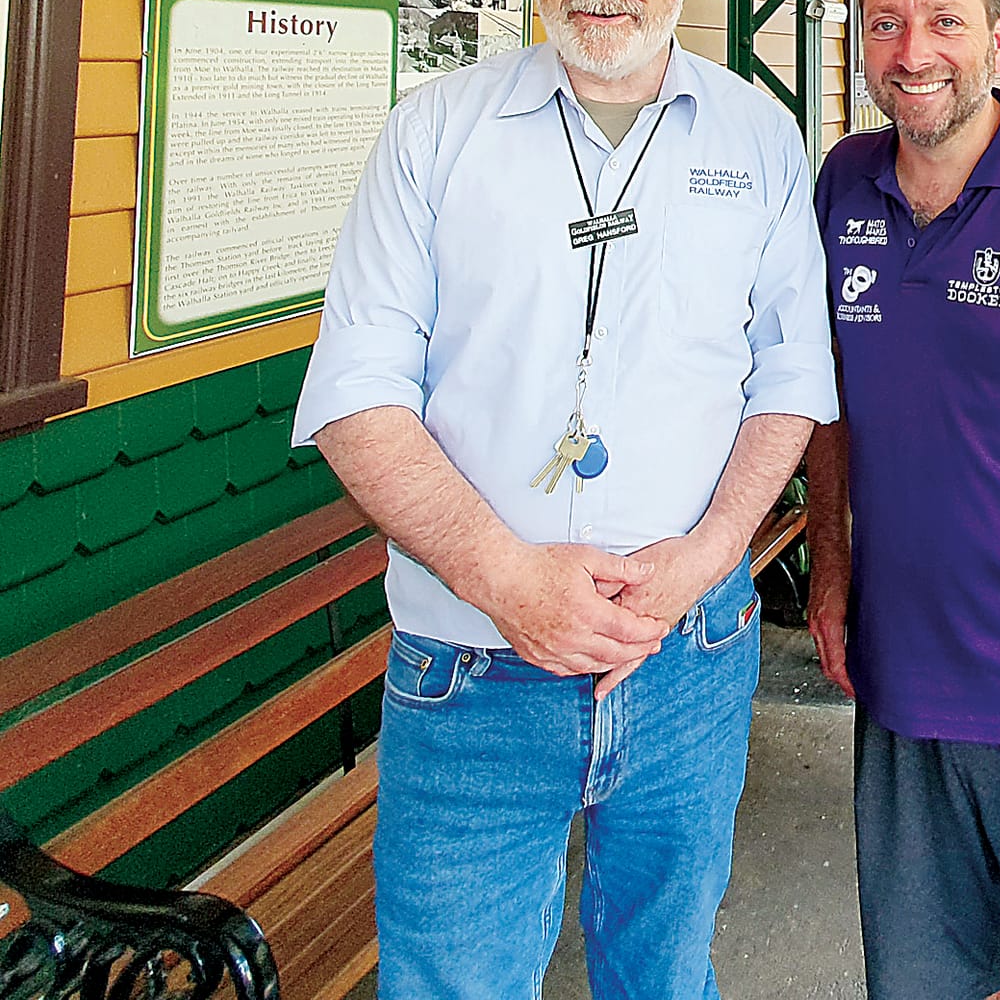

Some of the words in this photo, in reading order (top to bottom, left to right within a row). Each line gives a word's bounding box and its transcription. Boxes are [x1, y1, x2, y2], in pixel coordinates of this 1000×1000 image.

[248, 10, 338, 43] History
[689, 168, 750, 180] WALHALLA
[689, 177, 753, 190] GOLDFIELDS
[689, 186, 740, 198] RAILWAY
[573, 234, 594, 245] GREG
